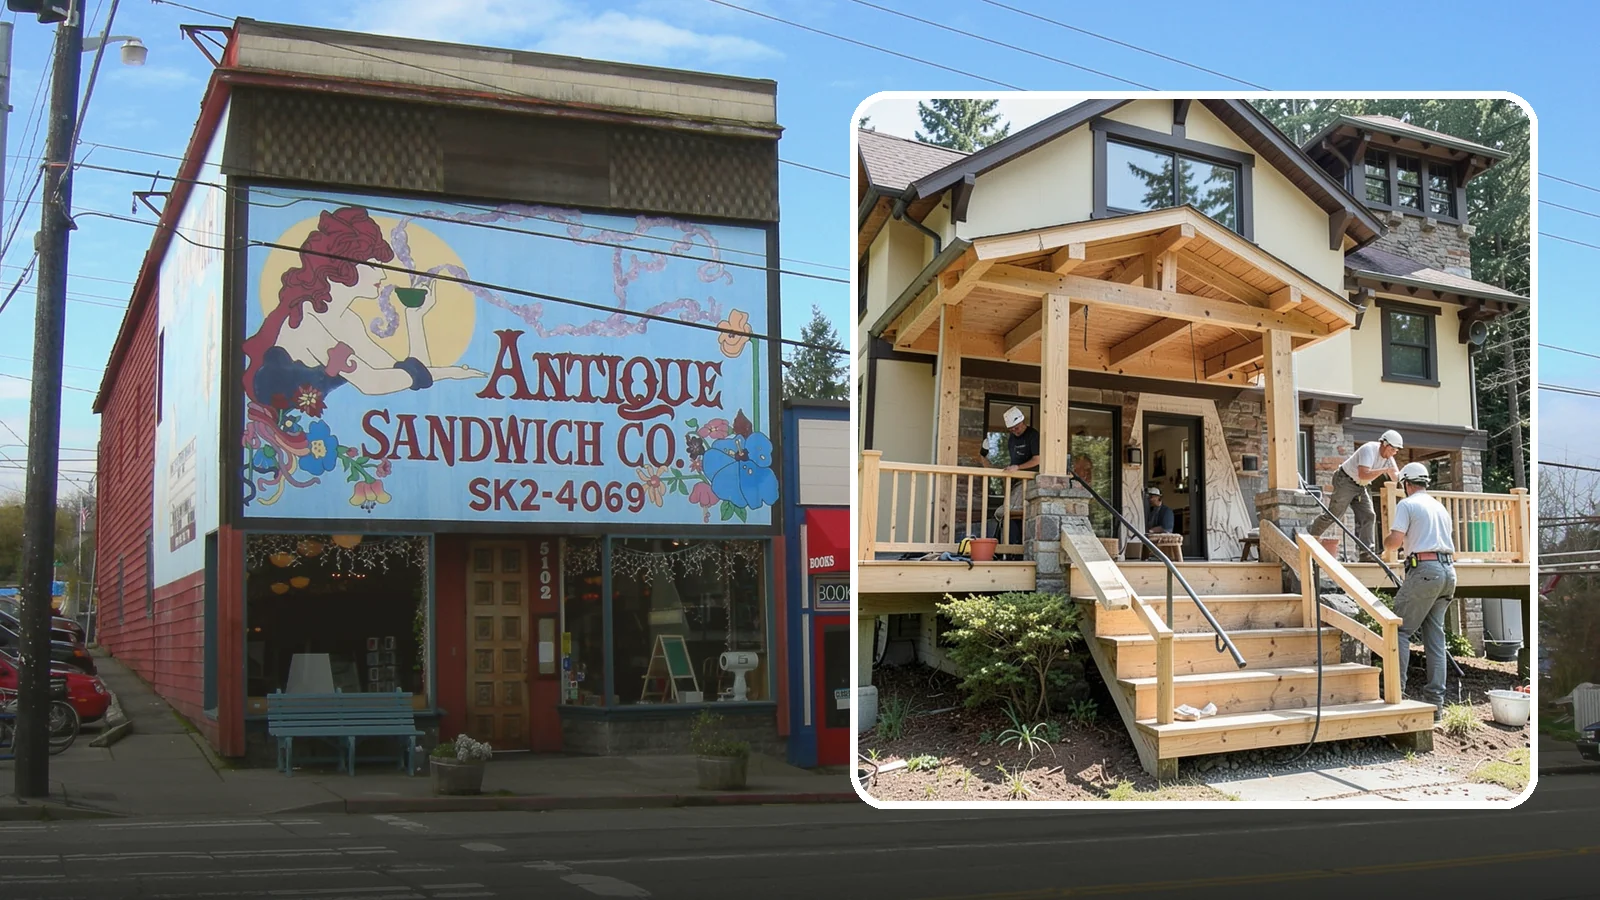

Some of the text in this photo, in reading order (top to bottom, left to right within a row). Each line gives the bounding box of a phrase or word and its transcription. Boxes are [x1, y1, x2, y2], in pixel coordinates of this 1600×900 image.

[475, 329, 724, 421] ANTIQUE
[361, 408, 685, 469] SANDWICH CO.
[468, 477, 646, 514] SK2-4069
[539, 541, 552, 600] 5102
[809, 555, 835, 569] BOOKS
